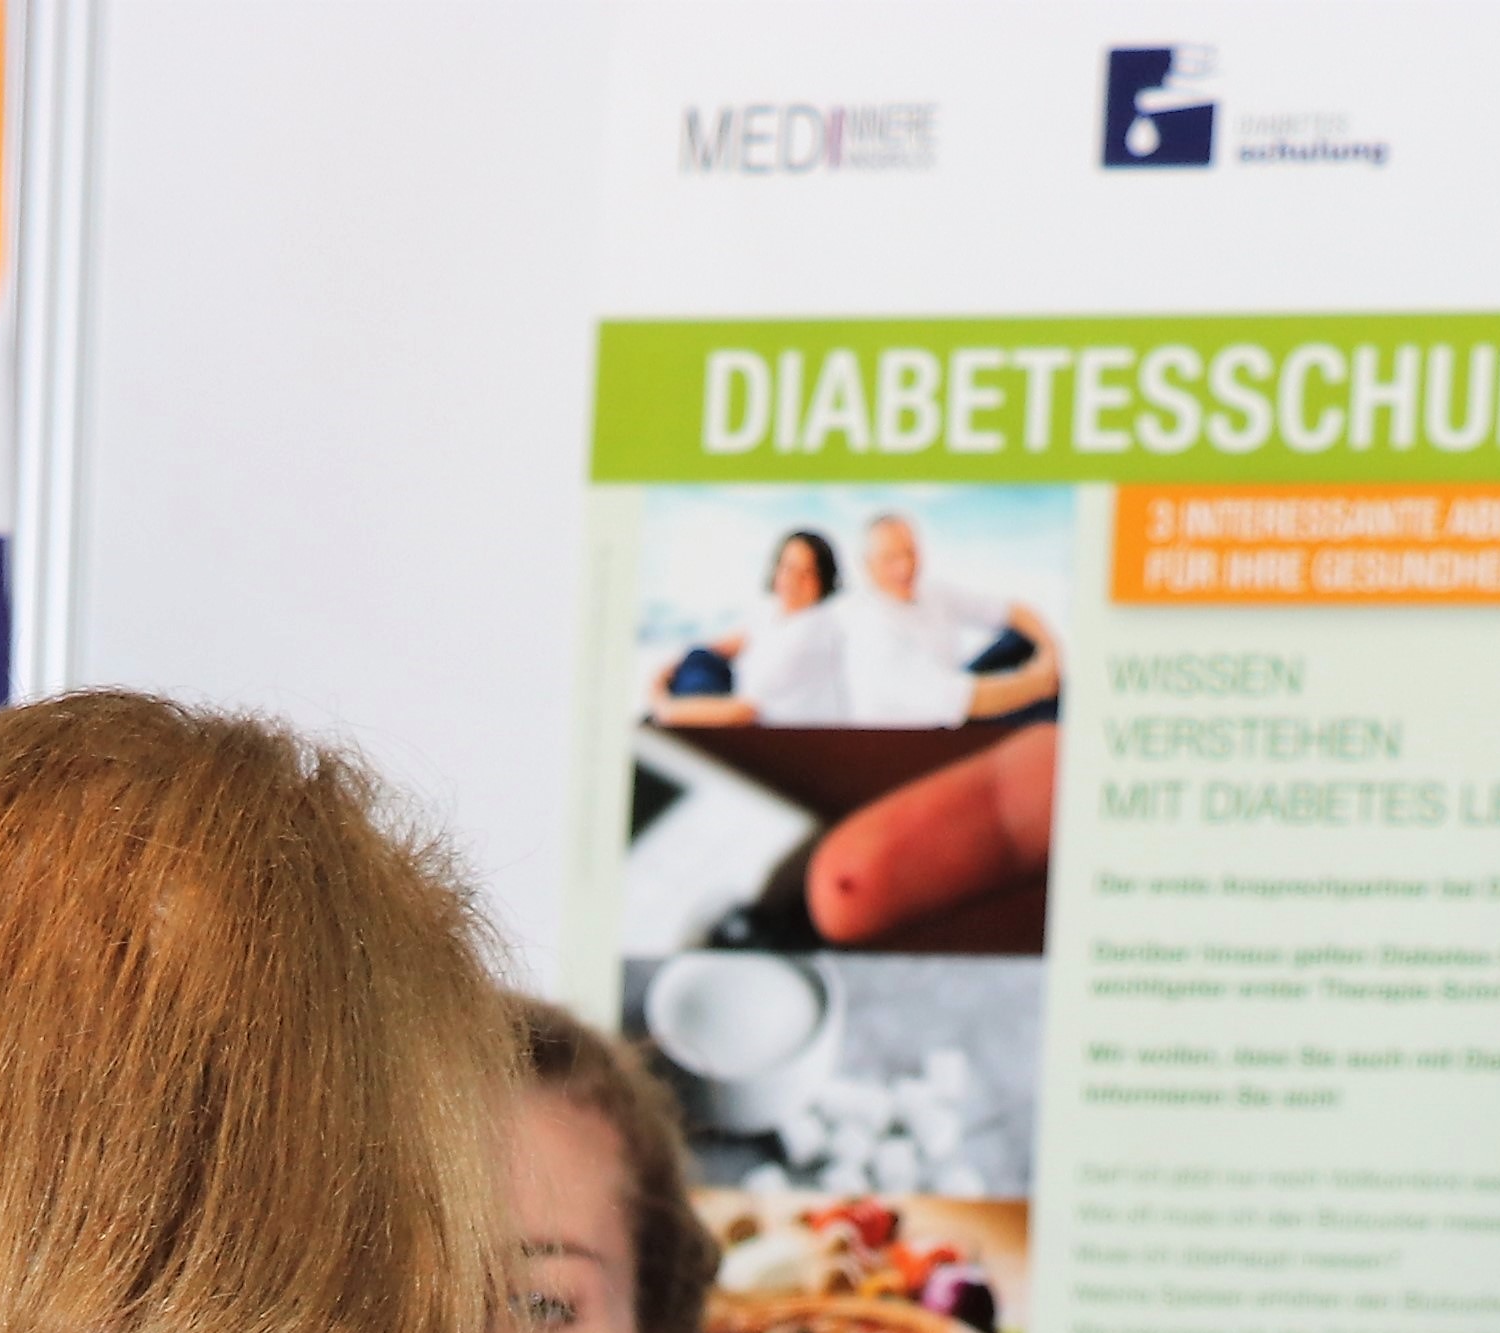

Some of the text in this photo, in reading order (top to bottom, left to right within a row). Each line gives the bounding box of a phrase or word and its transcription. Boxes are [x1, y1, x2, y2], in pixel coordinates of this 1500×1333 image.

[1239, 141, 1390, 168] schulung
[1180, 498, 1438, 540] INTERESSANTE
[1144, 545, 1219, 592] FÜR
[1223, 549, 1306, 591] IHRE
[1106, 653, 1305, 697] WISSEN
[1104, 716, 1404, 760] VERSTEHEN
[1101, 779, 1185, 822] MIT
[1203, 781, 1448, 825] DIABETES
